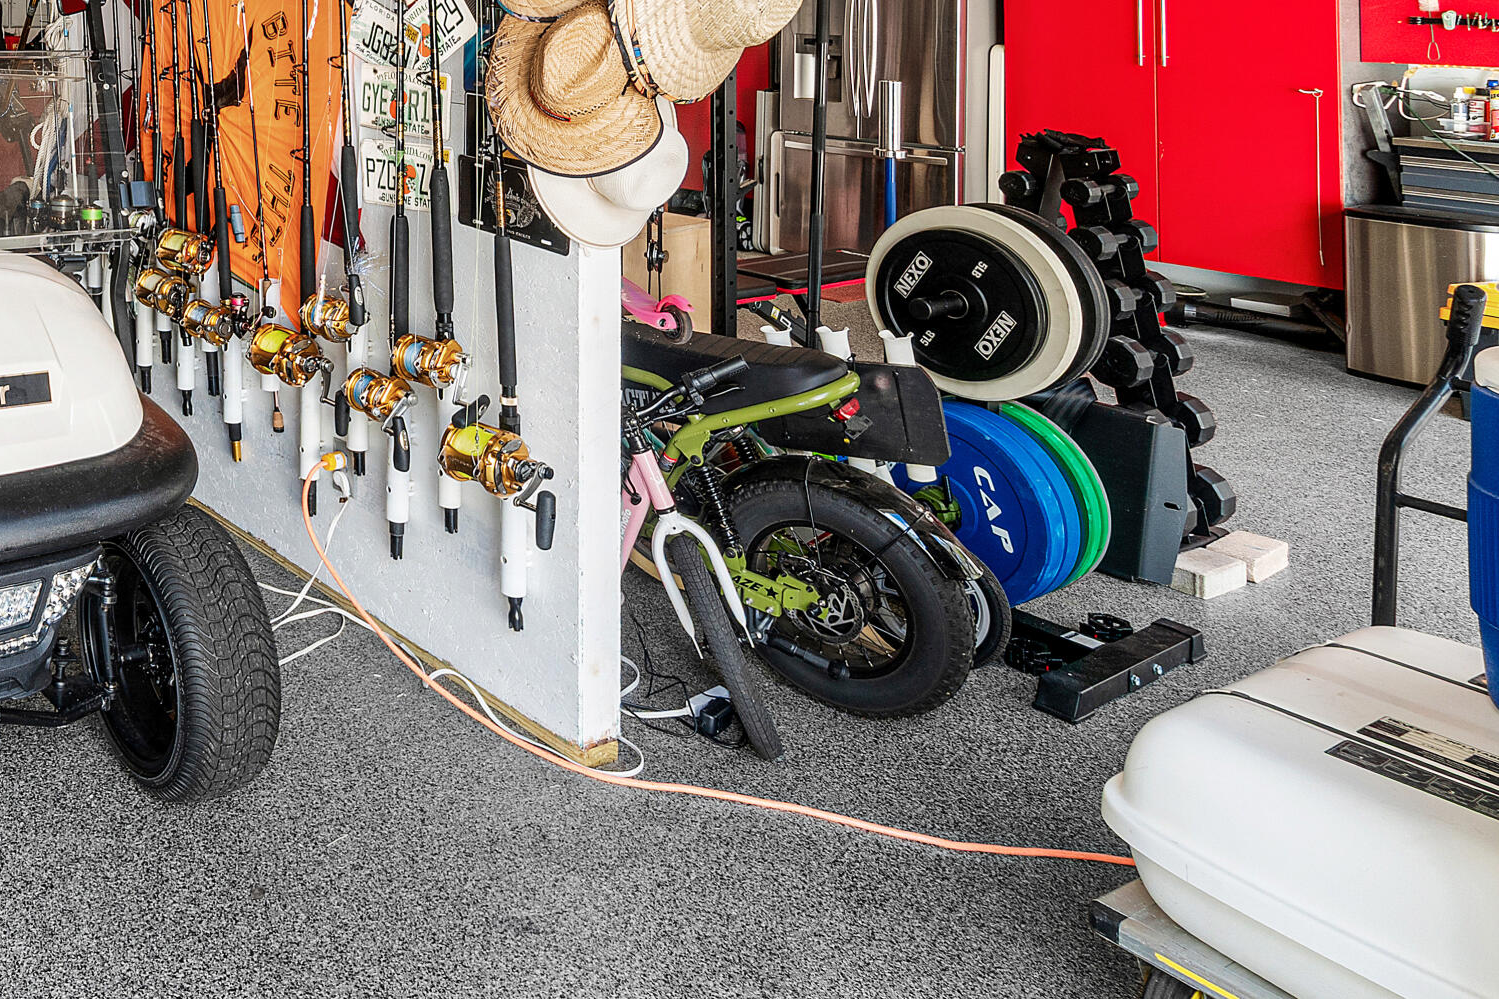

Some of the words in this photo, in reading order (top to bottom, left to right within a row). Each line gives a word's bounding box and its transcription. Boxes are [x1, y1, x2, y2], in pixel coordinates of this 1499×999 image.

[365, 0, 396, 23] FLORIDA
[438, 35, 458, 56] STATE
[261, 10, 301, 127] BITE
[362, 82, 389, 115] GYE
[404, 122, 426, 135] STATE
[895, 254, 931, 297] NEXO
[971, 260, 989, 279] 5LB
[920, 330, 936, 347] 5LB
[977, 312, 1015, 356] NEXO
[973, 466, 1014, 554] CAP
